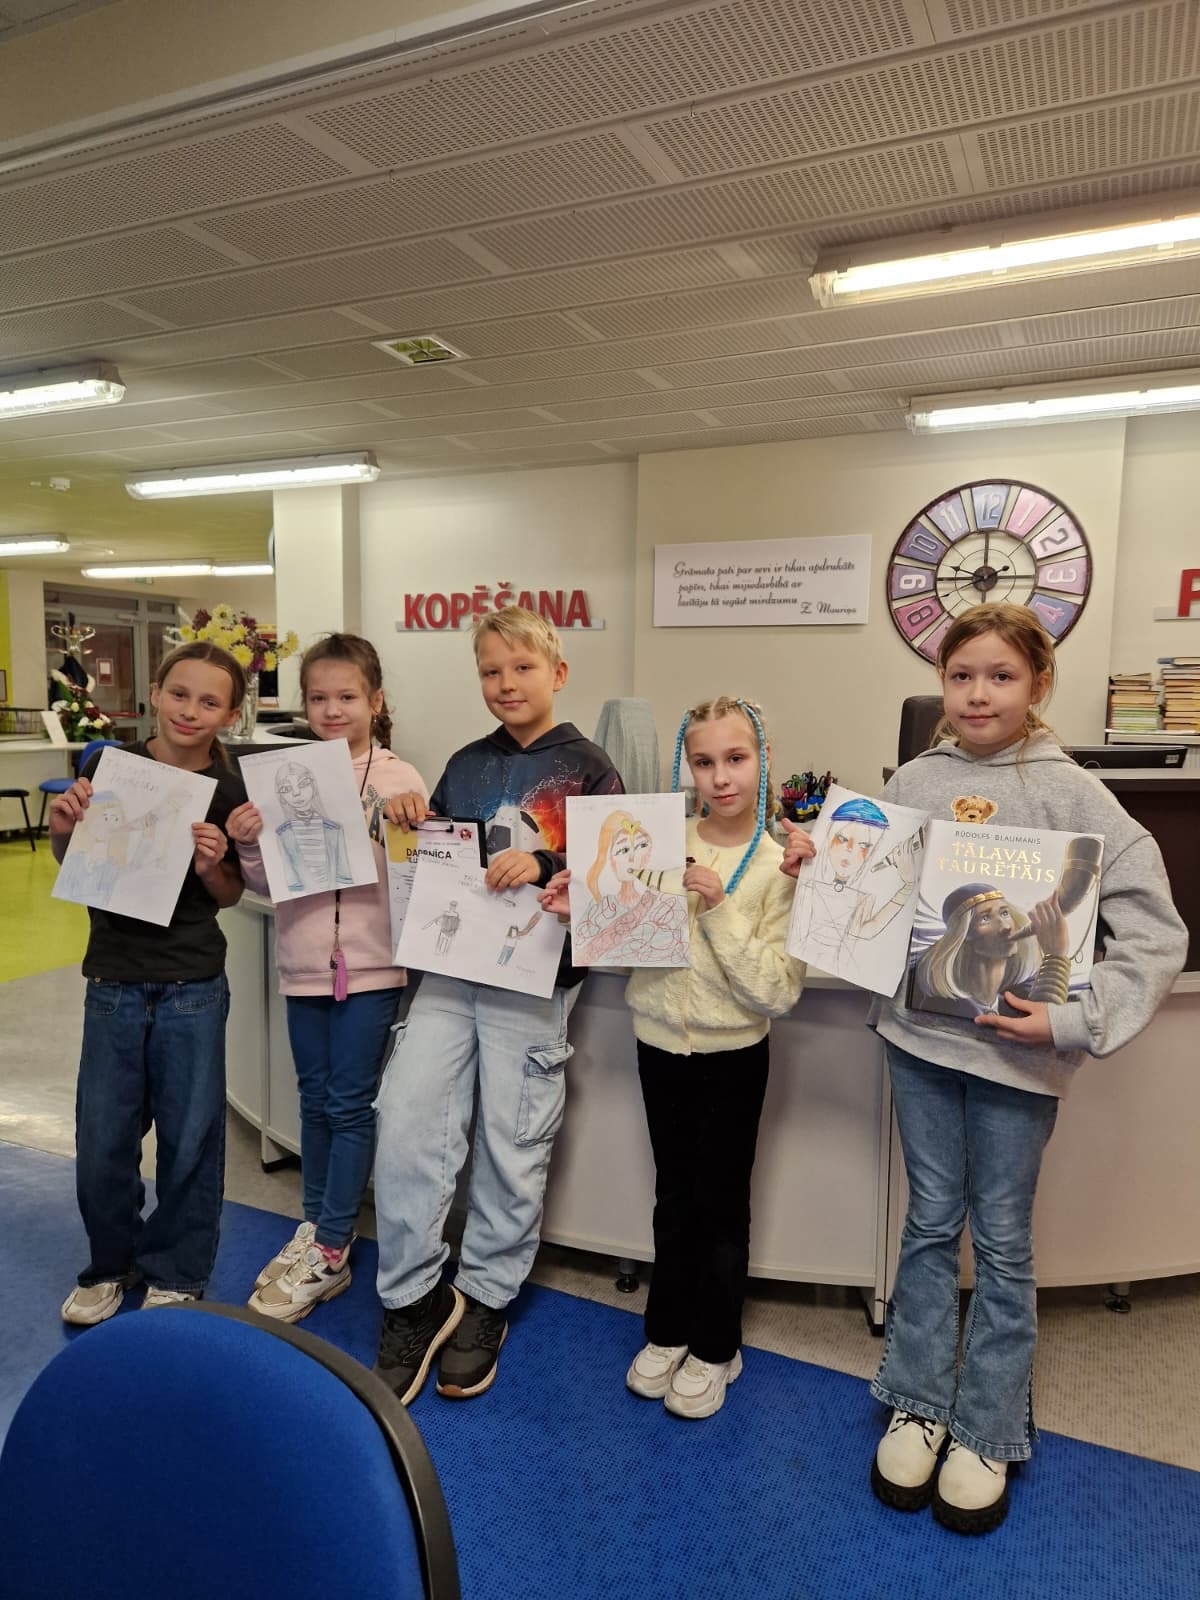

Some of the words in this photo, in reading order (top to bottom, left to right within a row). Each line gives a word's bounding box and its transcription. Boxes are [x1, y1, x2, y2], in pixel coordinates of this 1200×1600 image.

[982, 491, 1002, 521] 12
[1039, 527, 1068, 553] 2
[673, 560, 715, 578] Grāmata
[735, 567, 753, 577] par
[773, 562, 784, 573] ir
[1046, 568, 1077, 584] 3
[899, 574, 927, 590] 9
[906, 604, 934, 628] 8
[1034, 601, 1065, 625] 4
[955, 830, 990, 841] RŪDOLFS
[994, 833, 1041, 845] BLAUMANIS
[952, 842, 1042, 864] TĀLAVAS
[936, 854, 1056, 883] TAURĒTĀJS
